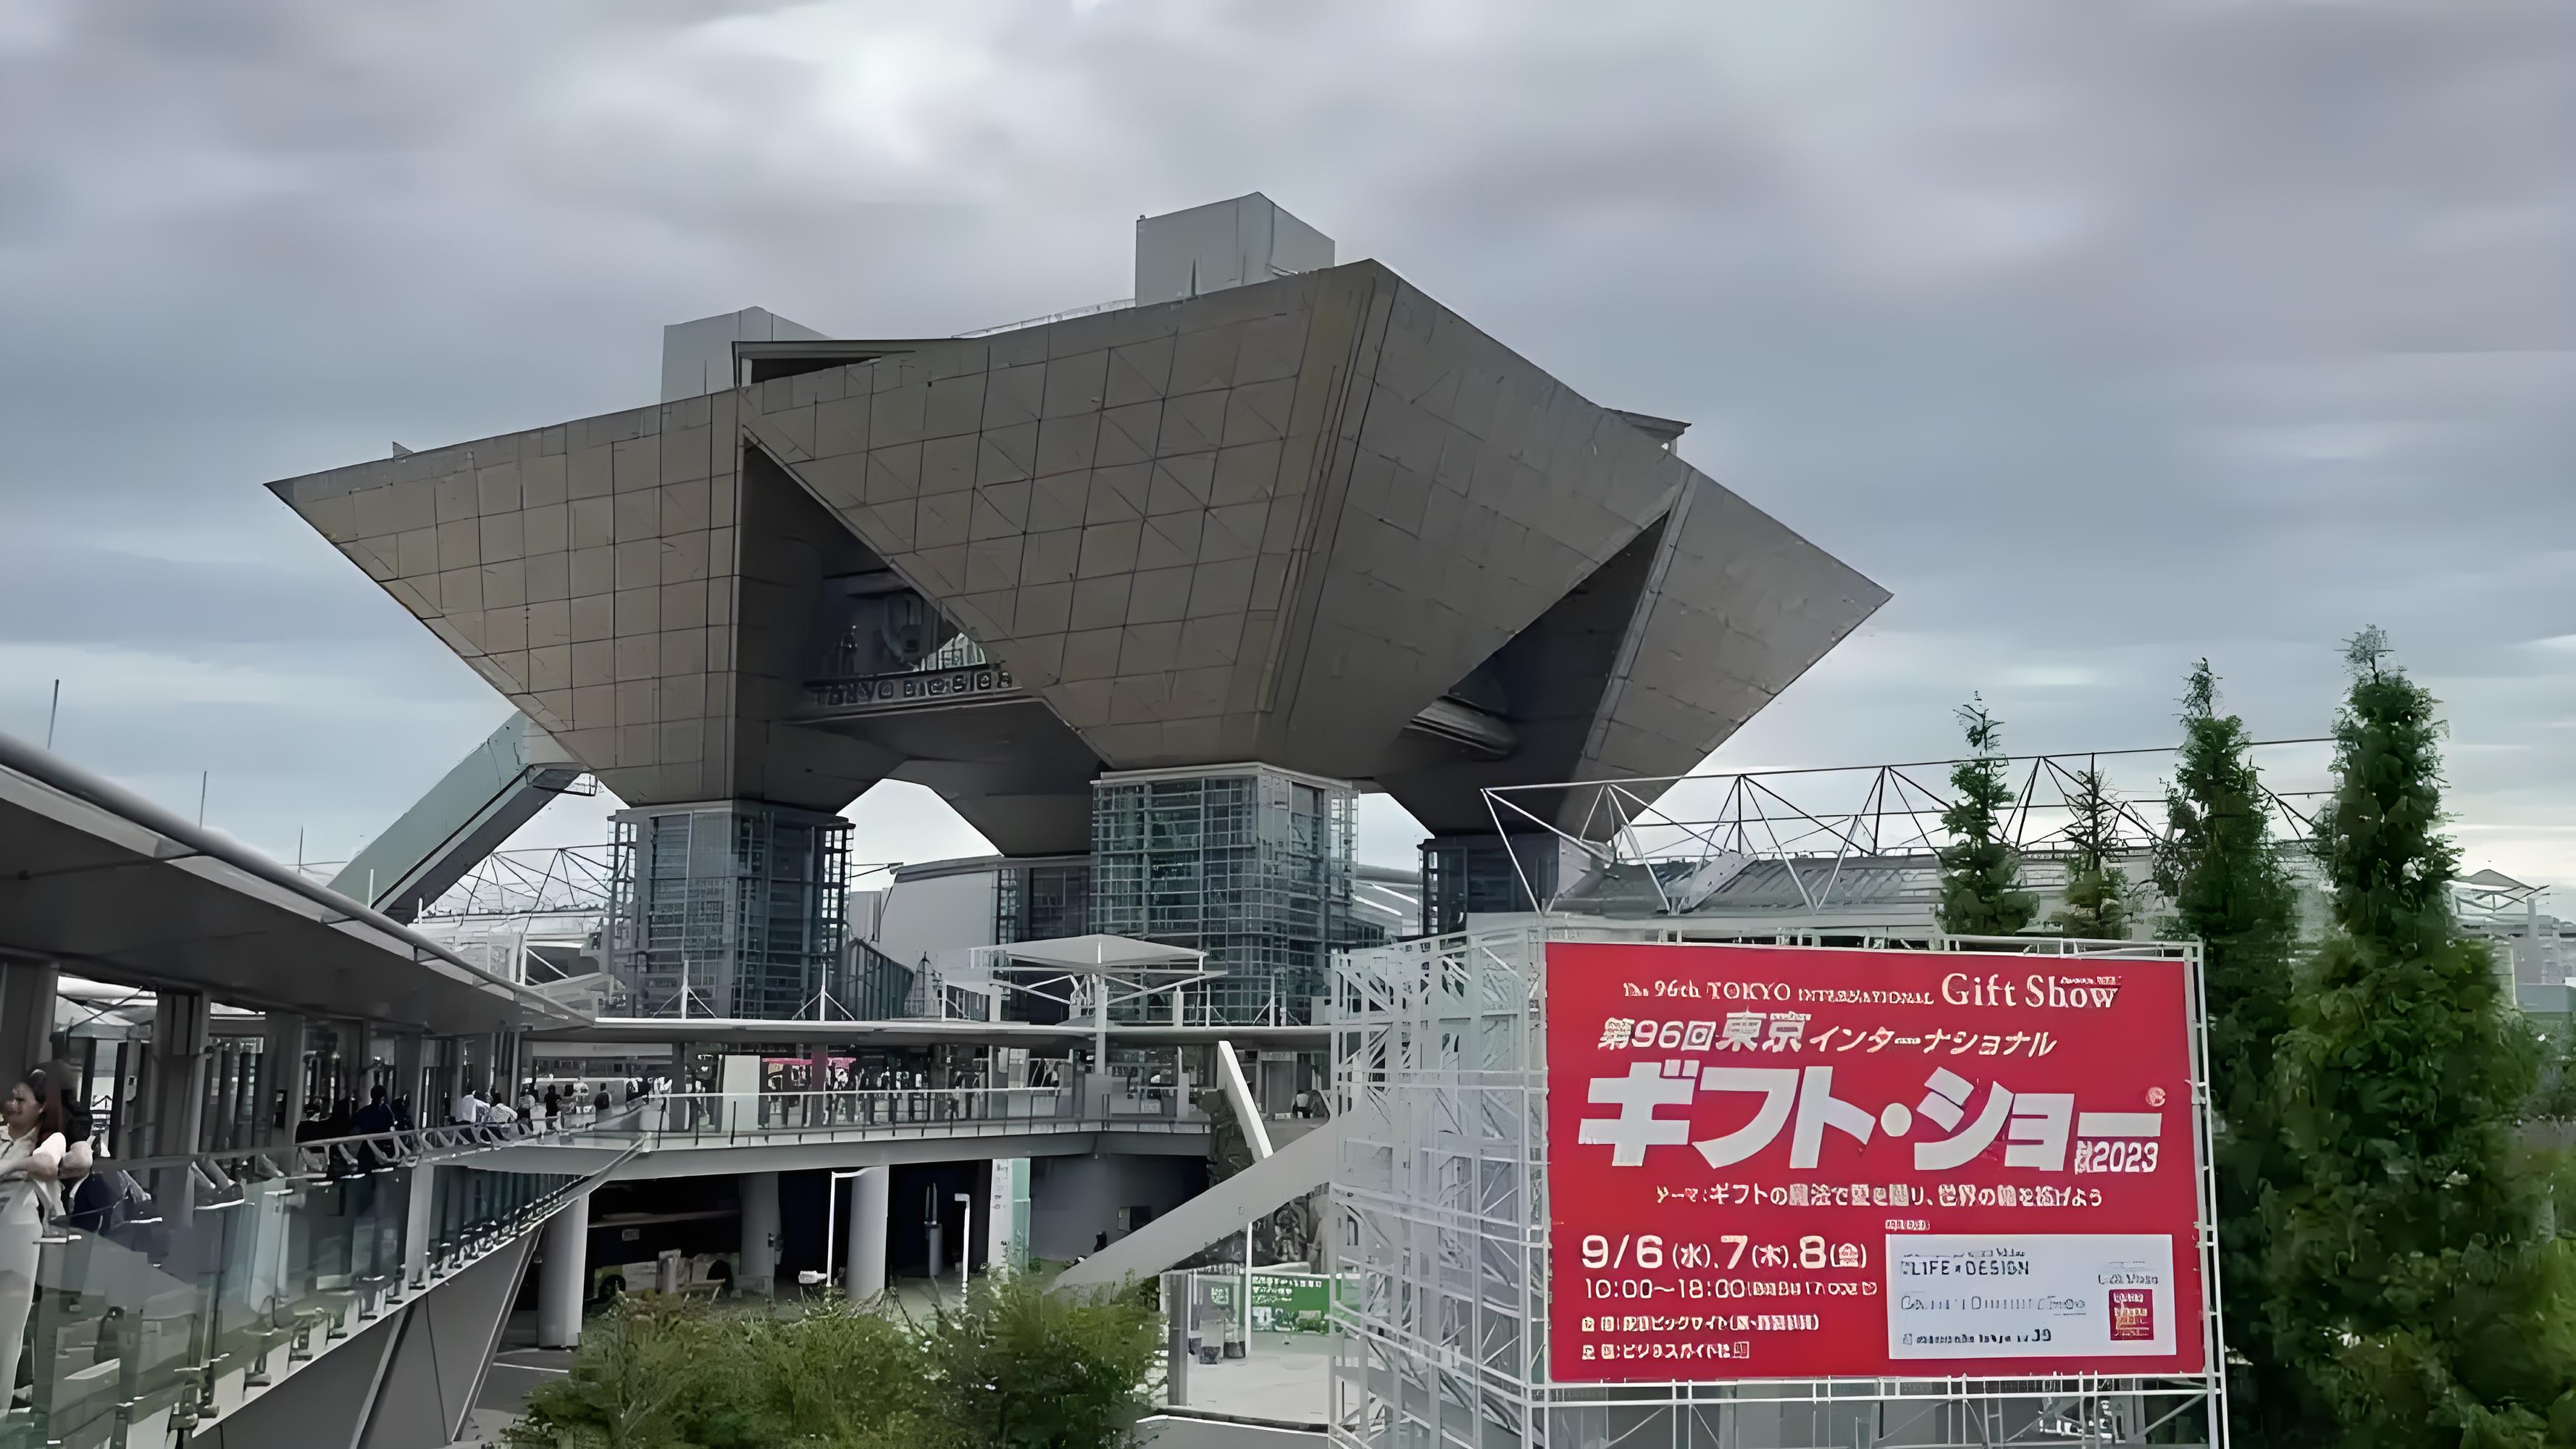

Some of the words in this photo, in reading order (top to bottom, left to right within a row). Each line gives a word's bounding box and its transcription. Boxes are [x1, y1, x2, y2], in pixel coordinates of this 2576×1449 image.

[1655, 980, 1701, 998] 96th
[1707, 981, 1791, 1001] TOKYO
[1942, 973, 2017, 1006] Gift
[2025, 974, 2119, 1008] Show
